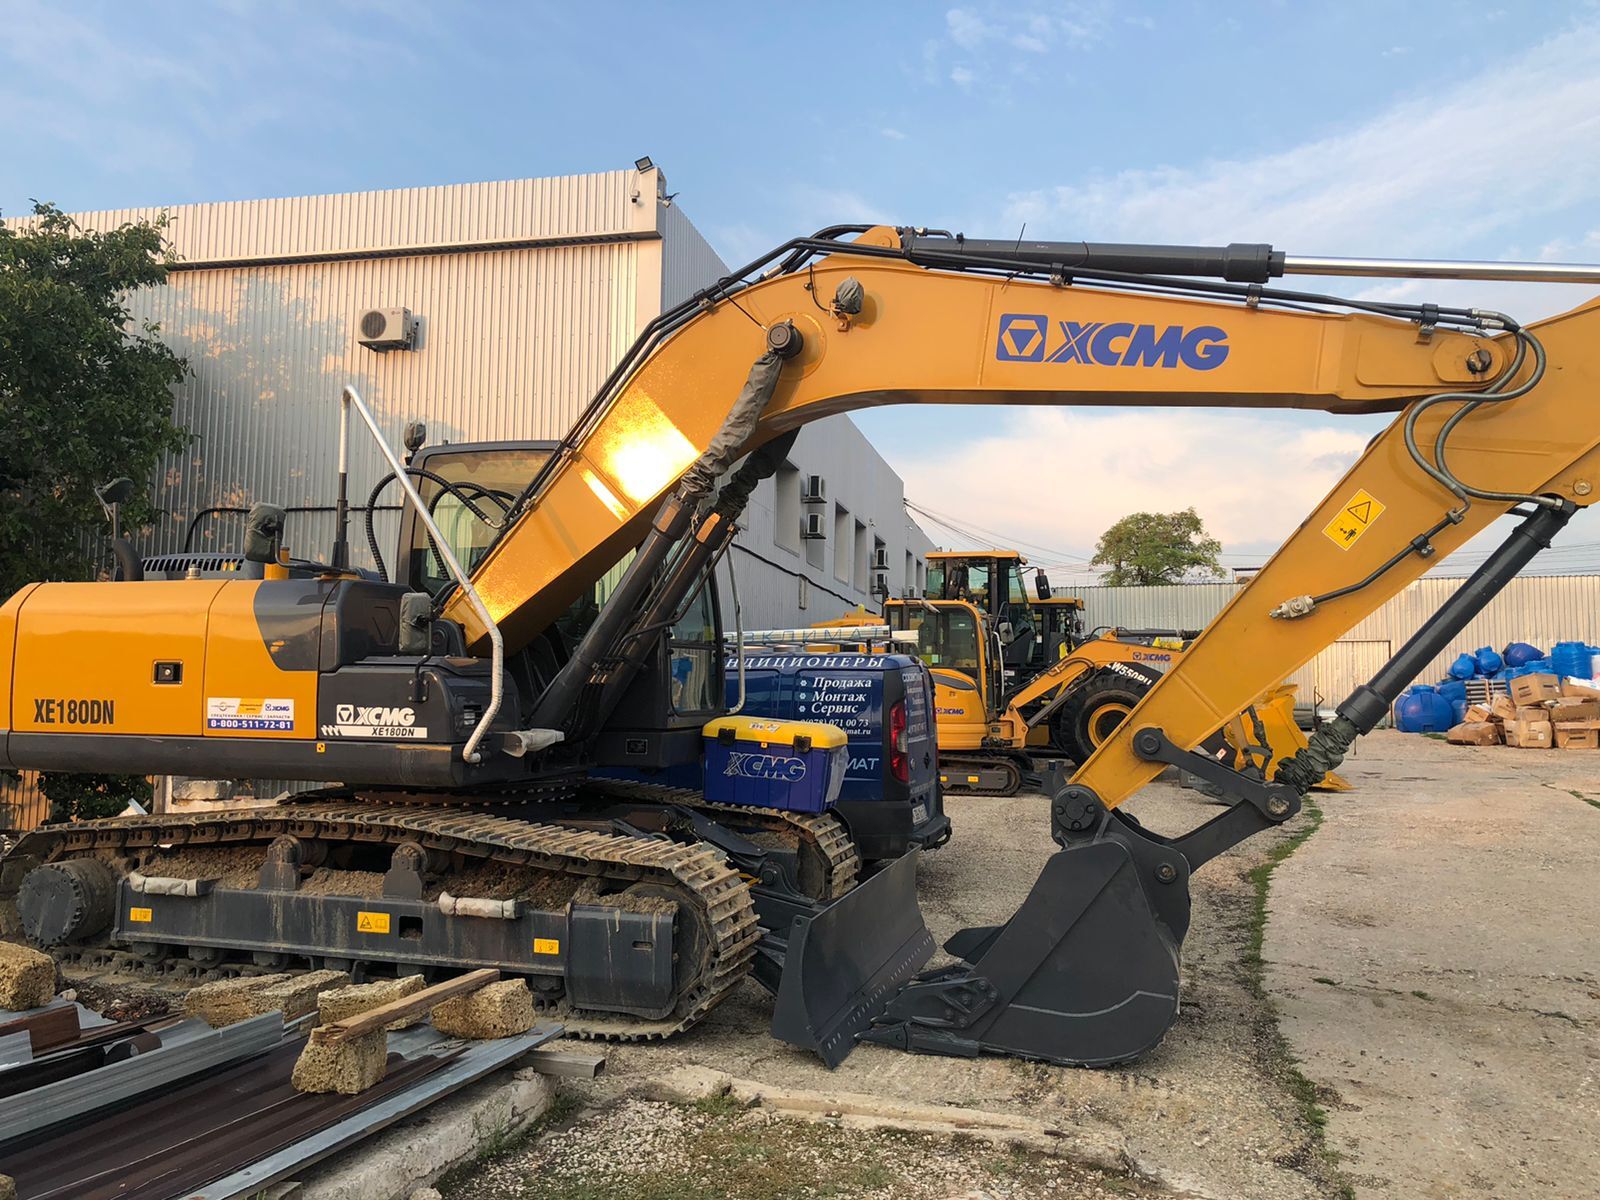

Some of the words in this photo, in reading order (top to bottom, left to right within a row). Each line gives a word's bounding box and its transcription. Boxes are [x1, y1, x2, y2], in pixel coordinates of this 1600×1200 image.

[1045, 321, 1230, 371] XCMG
[1143, 653, 1171, 662] XCMG
[812, 677, 872, 691] Продажа
[811, 691, 867, 702] Монтаж
[34, 699, 114, 724] XE180DN
[811, 702, 859, 716] Сервис
[354, 707, 415, 726] XCMG
[846, 719, 857, 727] 00
[859, 719, 869, 727] 73
[210, 719, 291, 729] 8-800-511-72-81
[371, 727, 415, 736] XE180DN
[723, 752, 806, 782] XCMG
